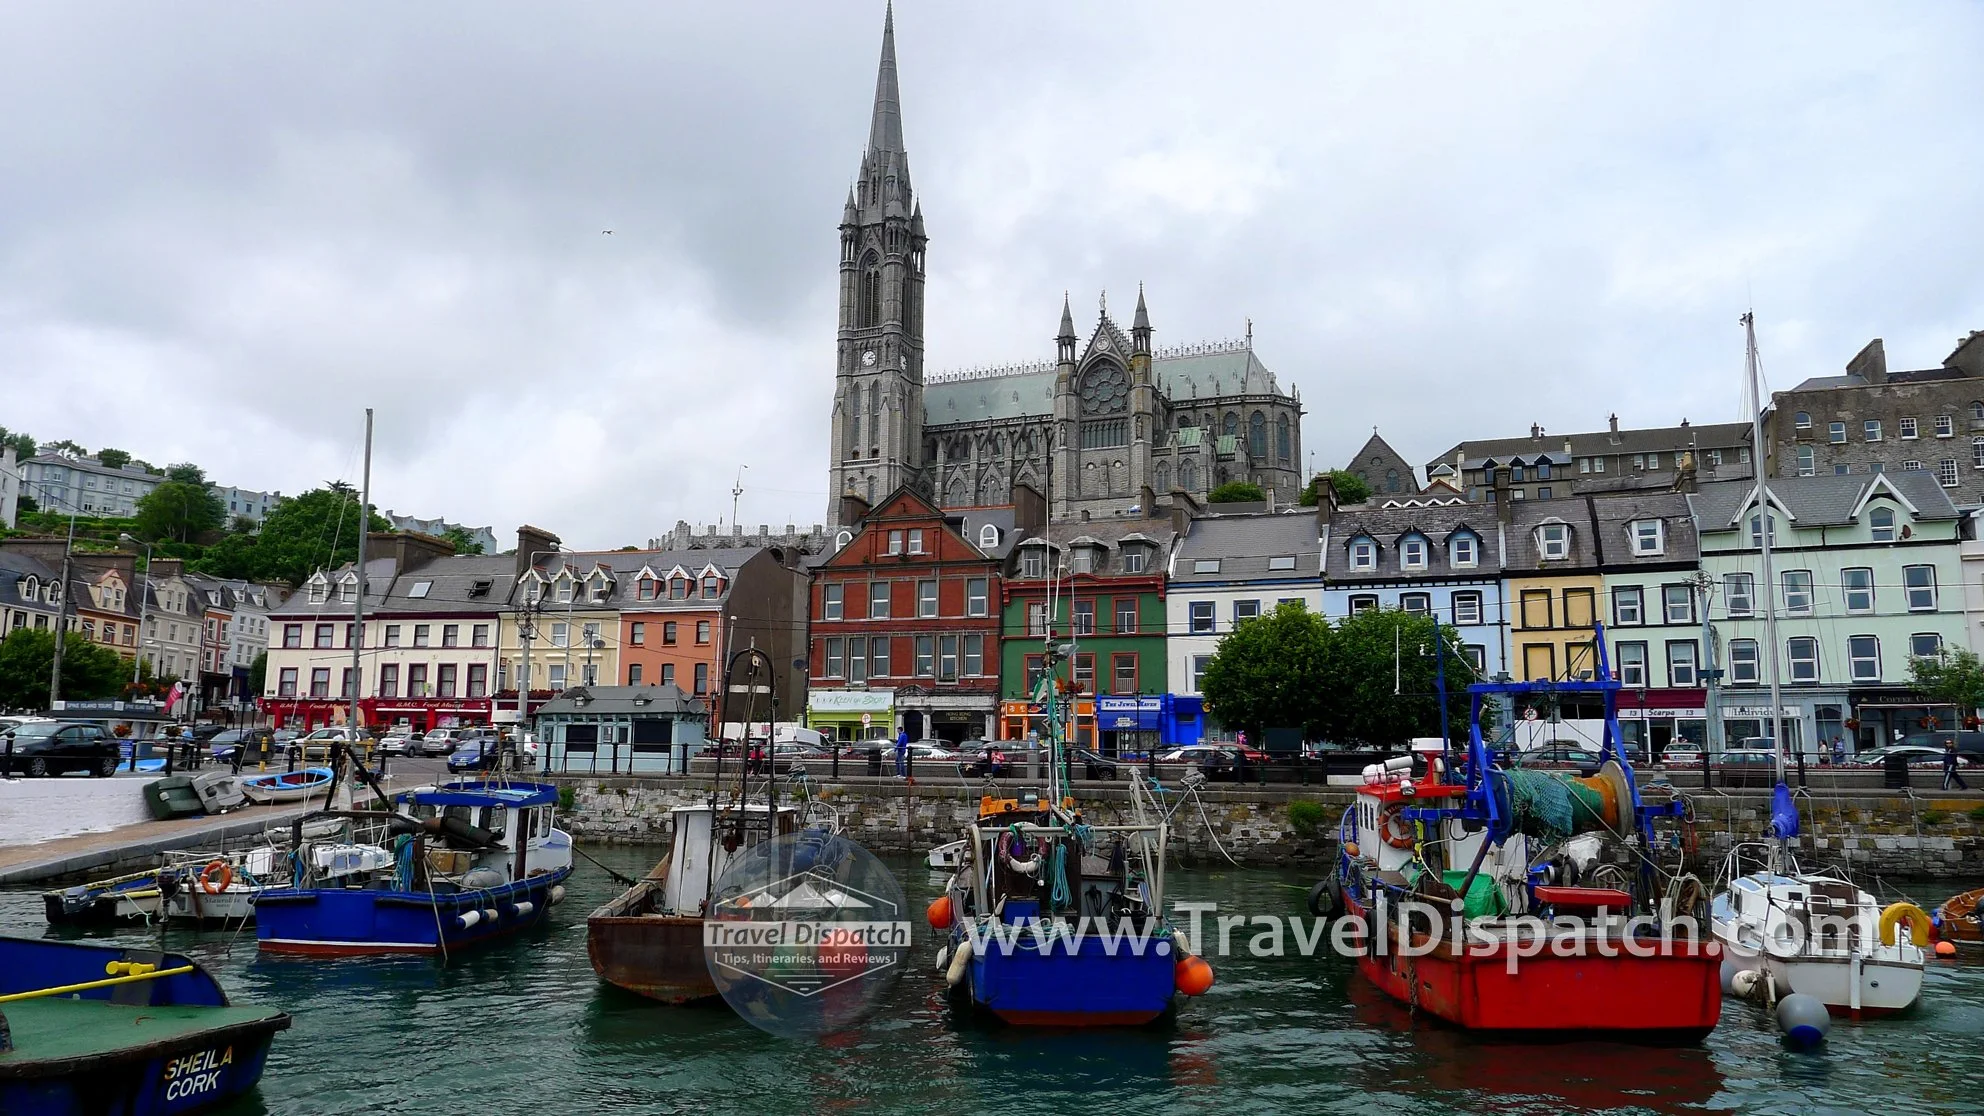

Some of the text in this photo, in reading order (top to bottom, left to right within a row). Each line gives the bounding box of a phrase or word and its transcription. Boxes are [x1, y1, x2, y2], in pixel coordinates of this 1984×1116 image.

[1648, 709, 1675, 717] Scarpa
[1733, 706, 1790, 716] Individuls
[164, 1045, 233, 1080] SHEILA
[166, 1070, 222, 1101] CORK
